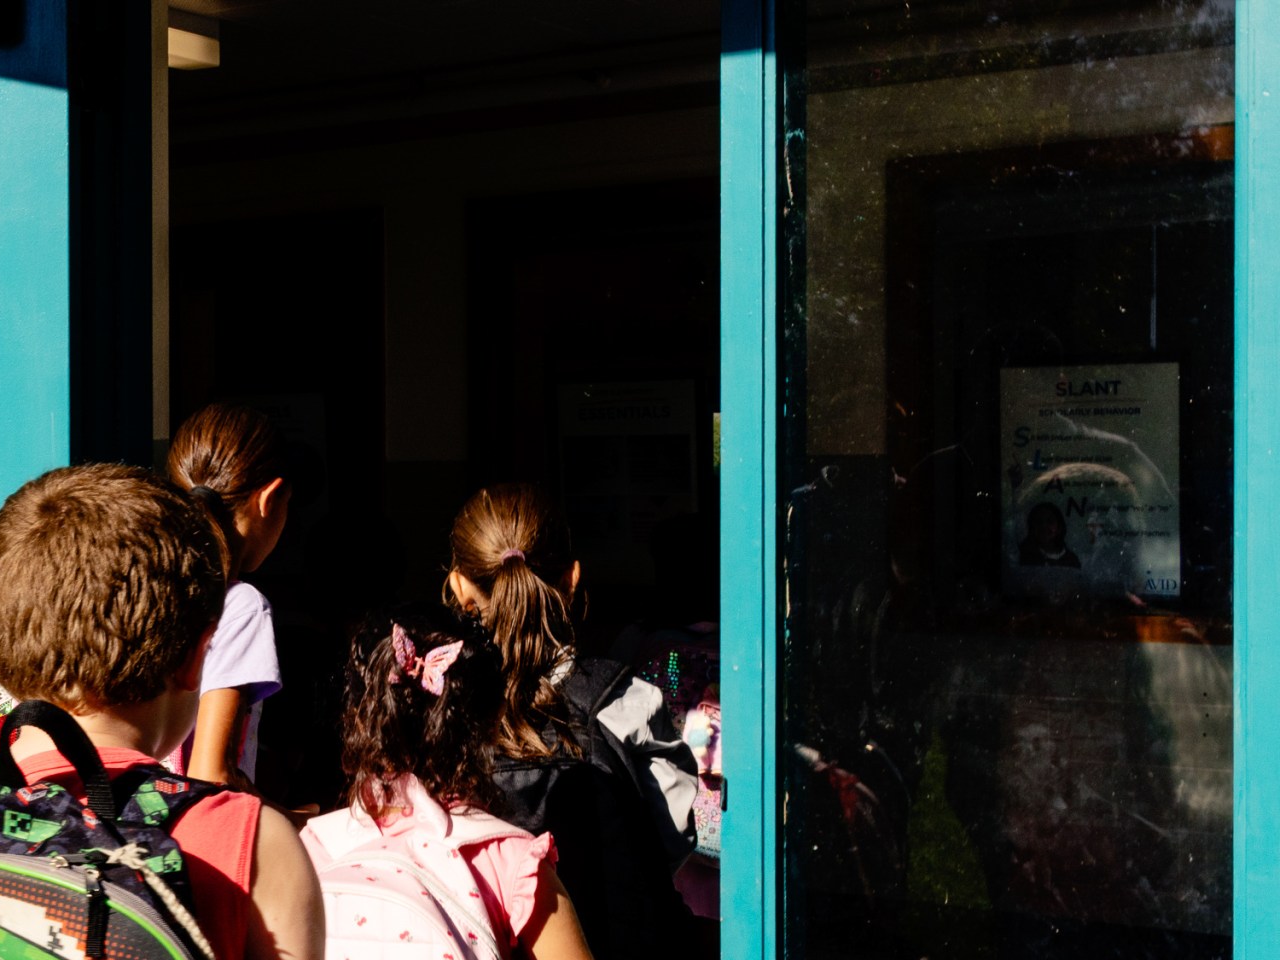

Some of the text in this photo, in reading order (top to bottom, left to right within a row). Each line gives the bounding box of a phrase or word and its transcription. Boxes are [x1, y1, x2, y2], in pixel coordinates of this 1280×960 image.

[1055, 380, 1122, 397] SLANT
[1093, 406, 1141, 416] BEHAVIOR
[1144, 579, 1177, 591] AVID
